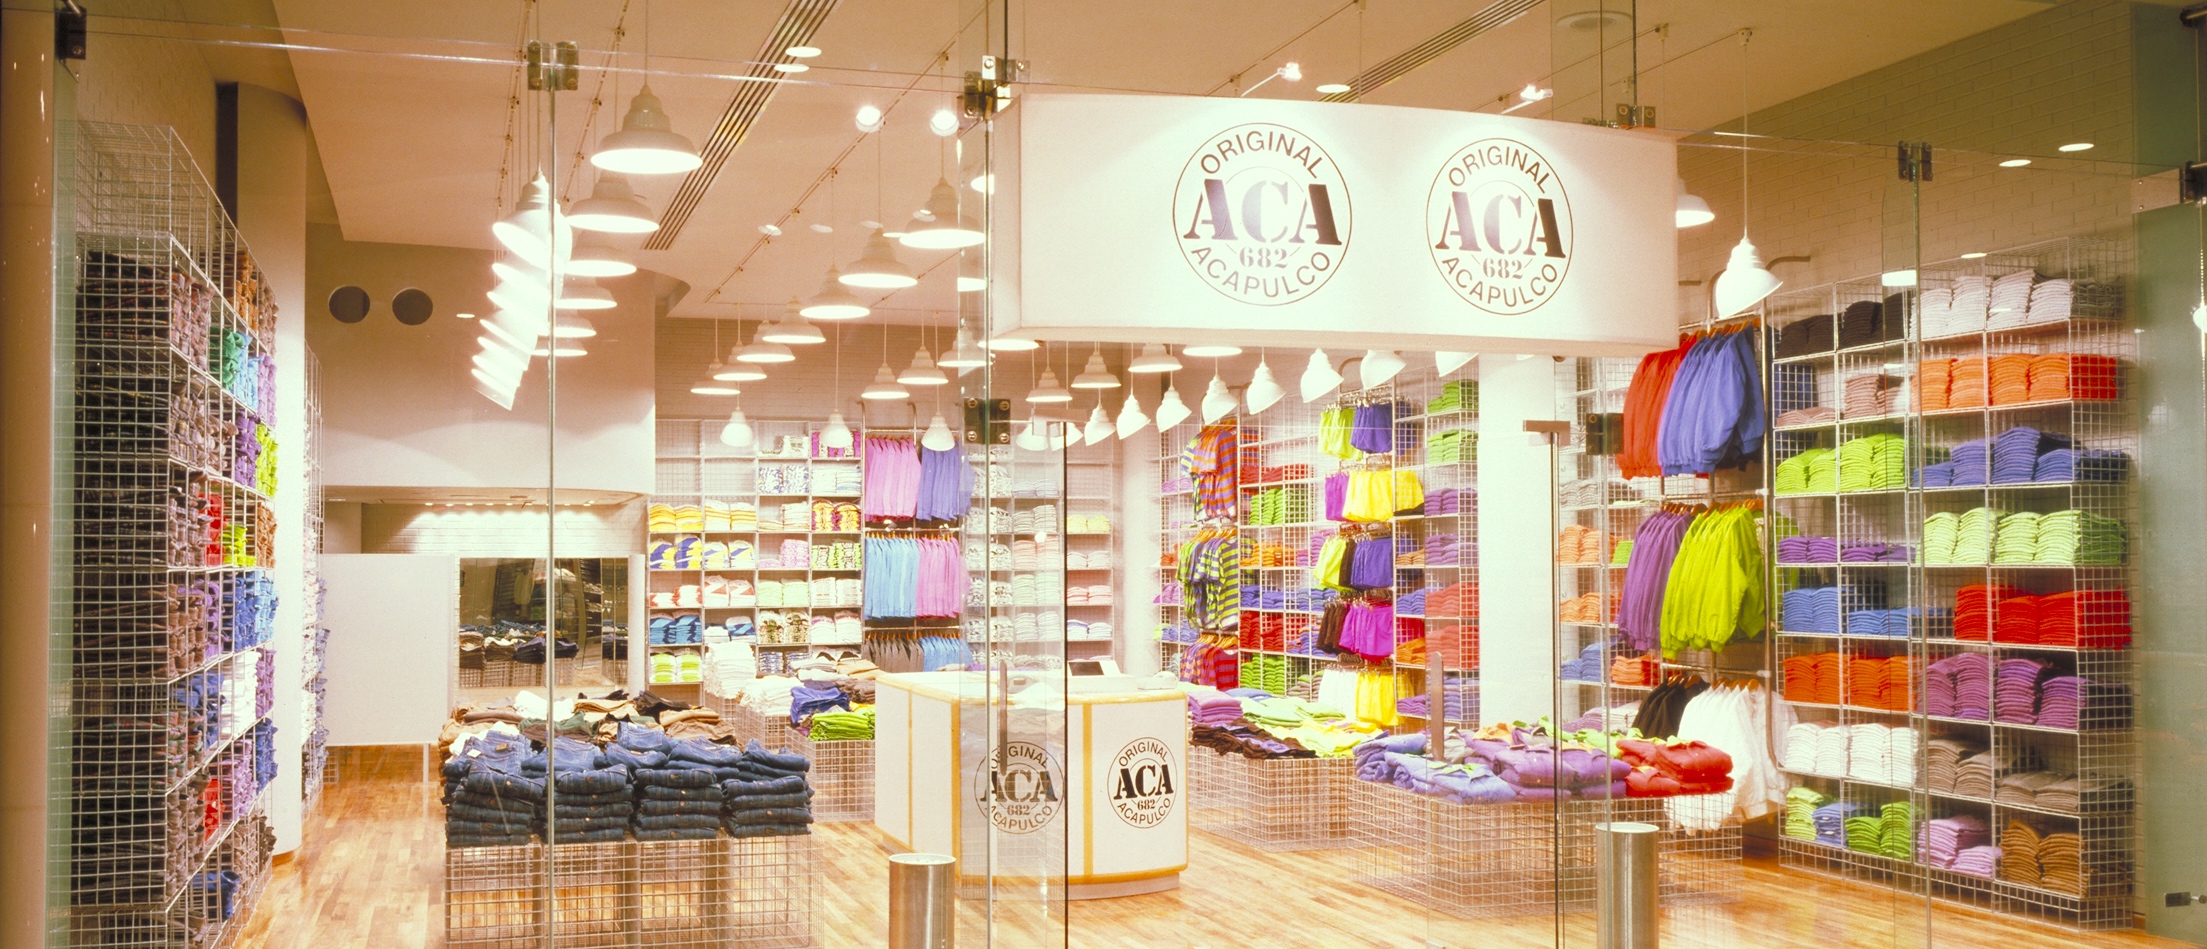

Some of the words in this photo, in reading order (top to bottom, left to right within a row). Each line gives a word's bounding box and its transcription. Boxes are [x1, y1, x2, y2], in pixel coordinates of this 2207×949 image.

[1200, 130, 1322, 179] ORIGINAL
[1448, 145, 1550, 194] ORIGINAL
[1183, 178, 1342, 246] ACA
[1435, 190, 1566, 259] ACA
[1190, 247, 1330, 298] ACAPULCO
[1239, 247, 1288, 269] 682
[1482, 257, 1524, 280] 682
[1441, 257, 1557, 308] ACAPULCO
[1118, 741, 1168, 767] ORIGINAL
[980, 769, 1058, 803] ACA
[1113, 764, 1174, 800] ACA
[1006, 804, 1031, 816] 682
[1117, 798, 1171, 825] ACAPULCO
[1137, 799, 1156, 811] 682
